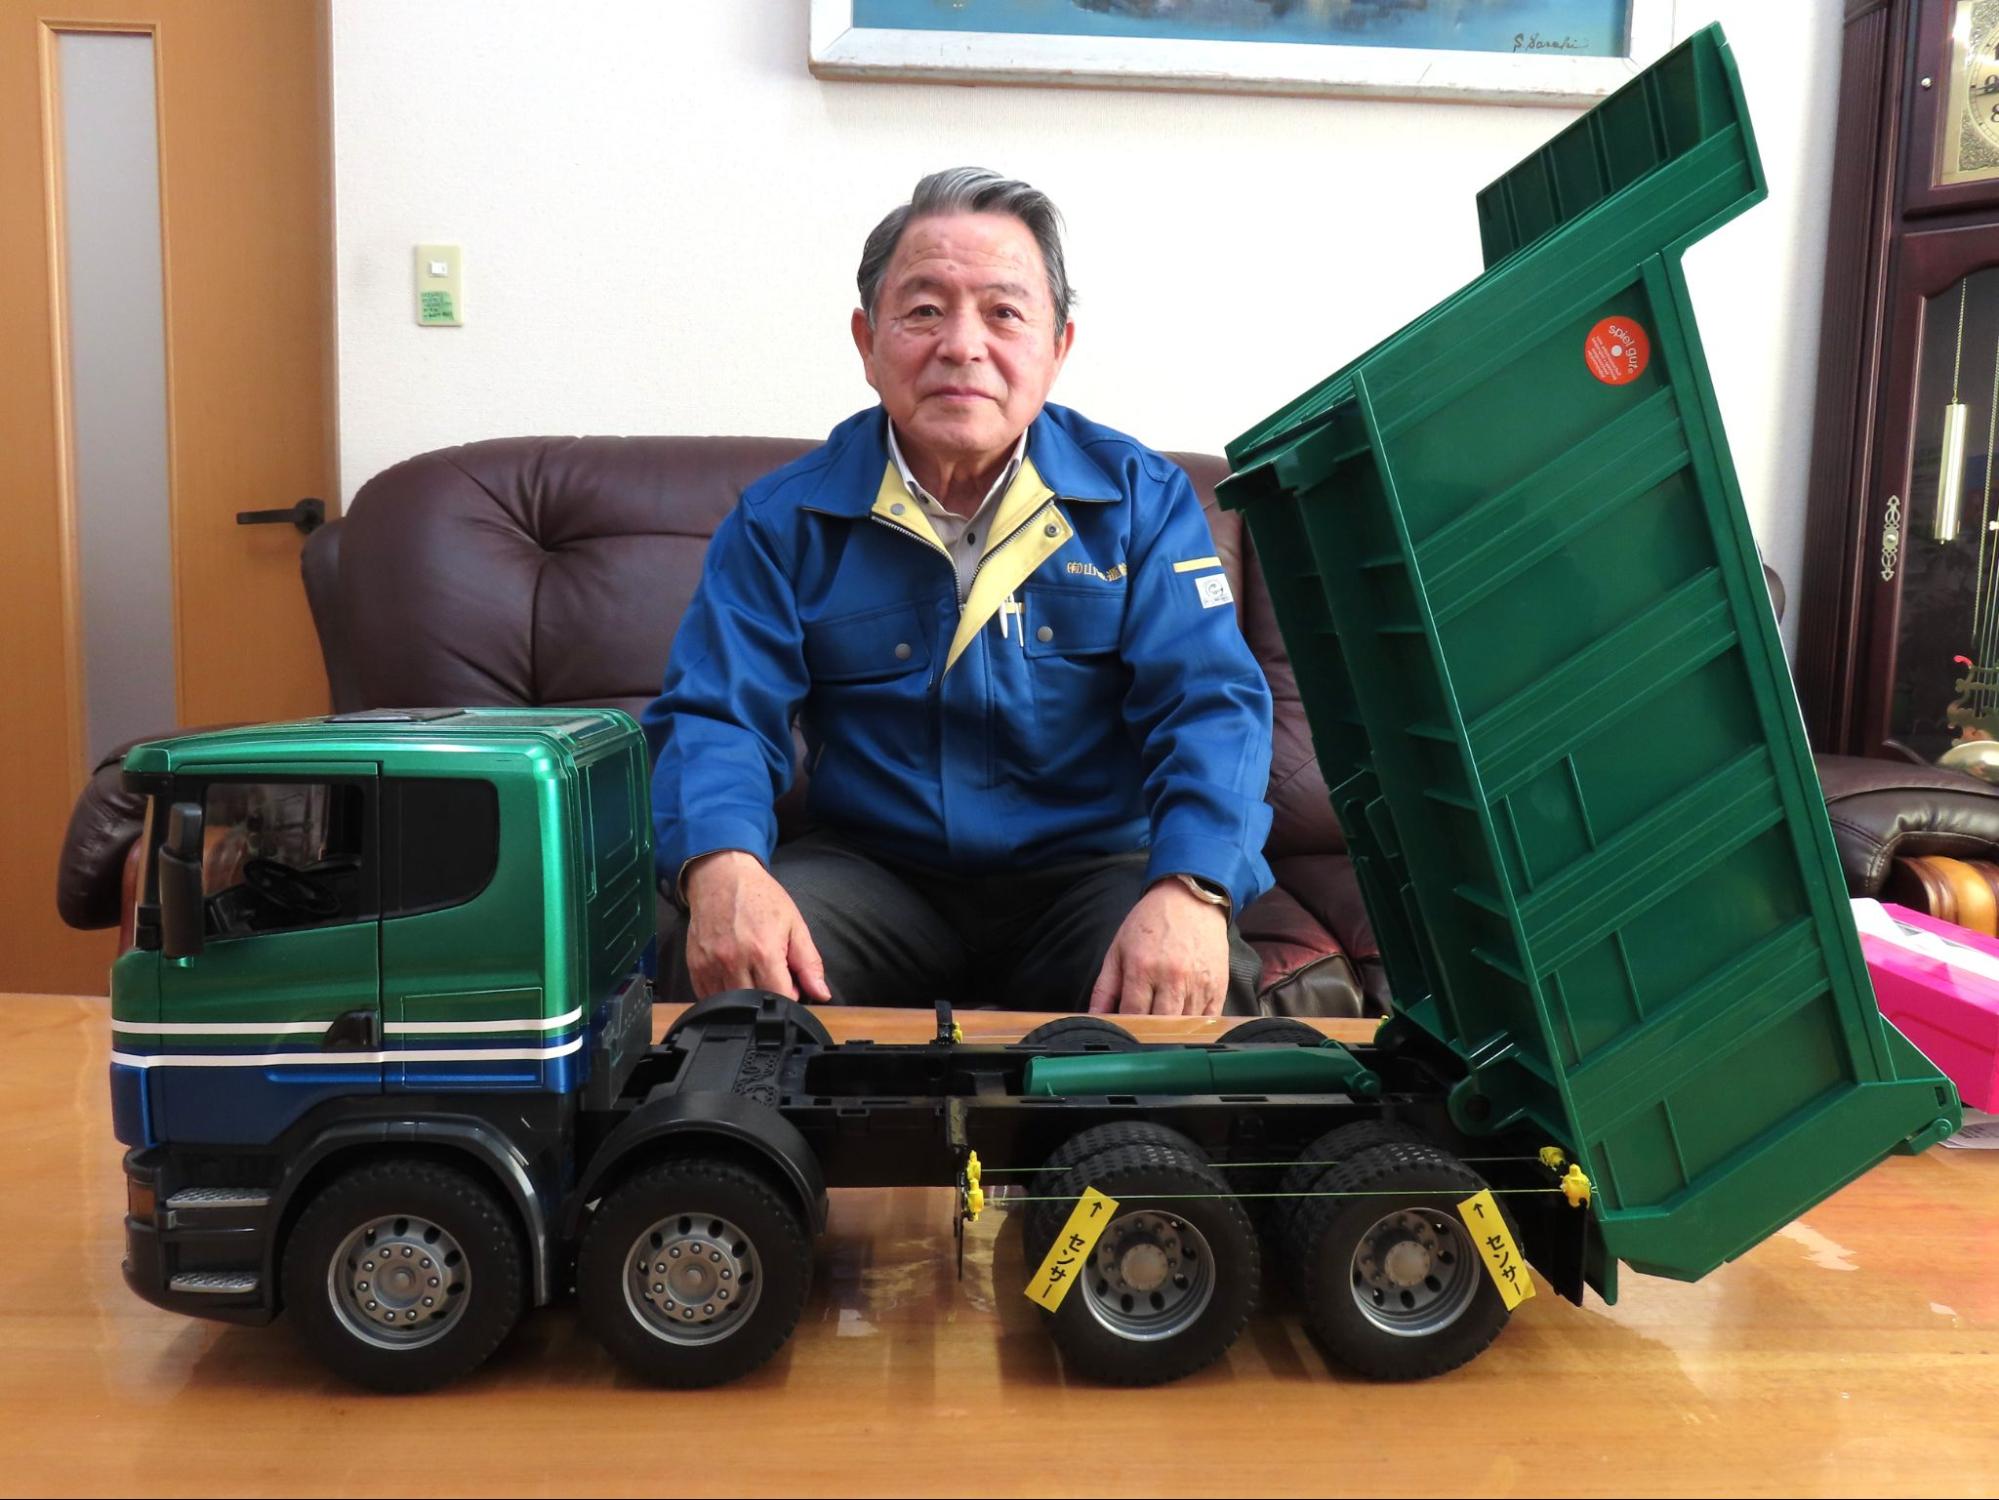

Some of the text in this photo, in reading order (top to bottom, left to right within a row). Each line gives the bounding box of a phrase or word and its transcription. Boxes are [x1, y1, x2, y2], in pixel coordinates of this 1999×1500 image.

[1608, 325, 1635, 347] spiel
[1042, 1233, 1085, 1298] センサー
[1486, 1234, 1521, 1296] センサー
